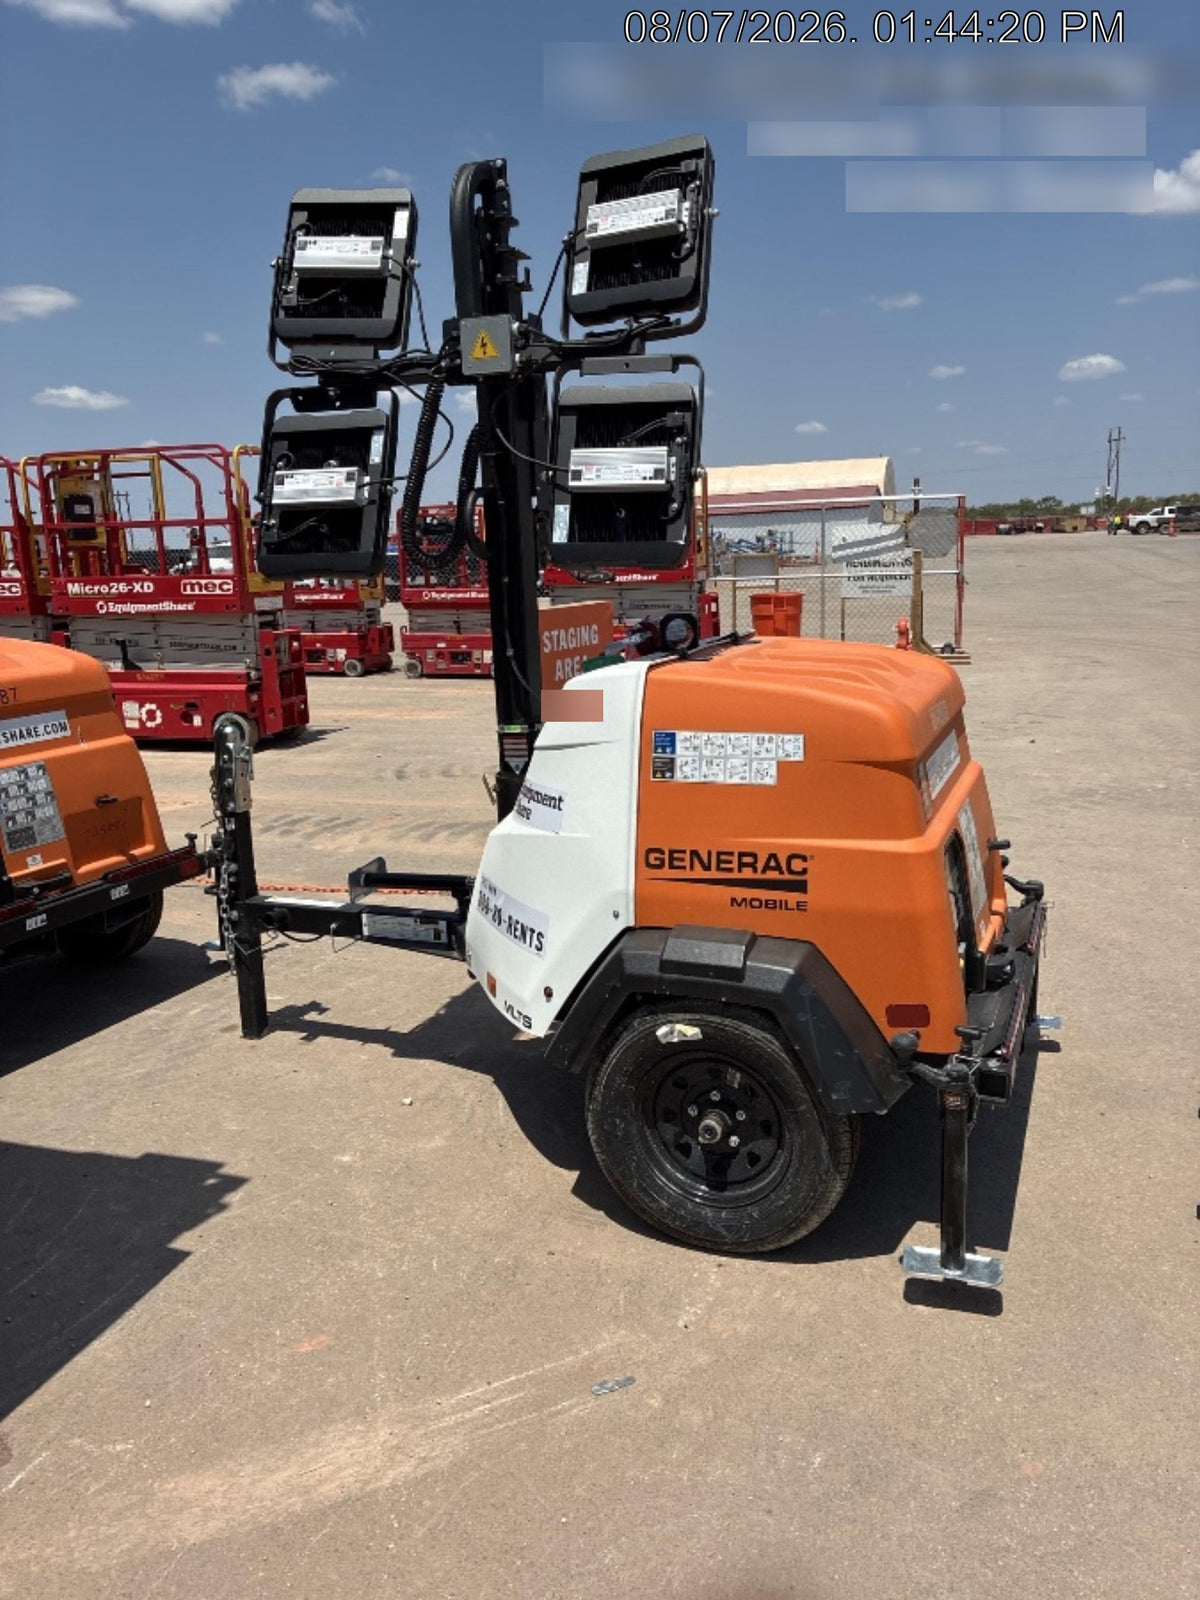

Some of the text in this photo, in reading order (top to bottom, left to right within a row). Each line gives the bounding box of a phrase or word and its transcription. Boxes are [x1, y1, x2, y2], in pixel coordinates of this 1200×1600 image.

[67, 582, 154, 595] Micro26-XD
[182, 580, 233, 593] mec
[542, 623, 599, 653] STAGING
[0, 720, 68, 744] SHARE.COM
[645, 847, 809, 876] GENERAC
[730, 897, 808, 912] MOBILE
